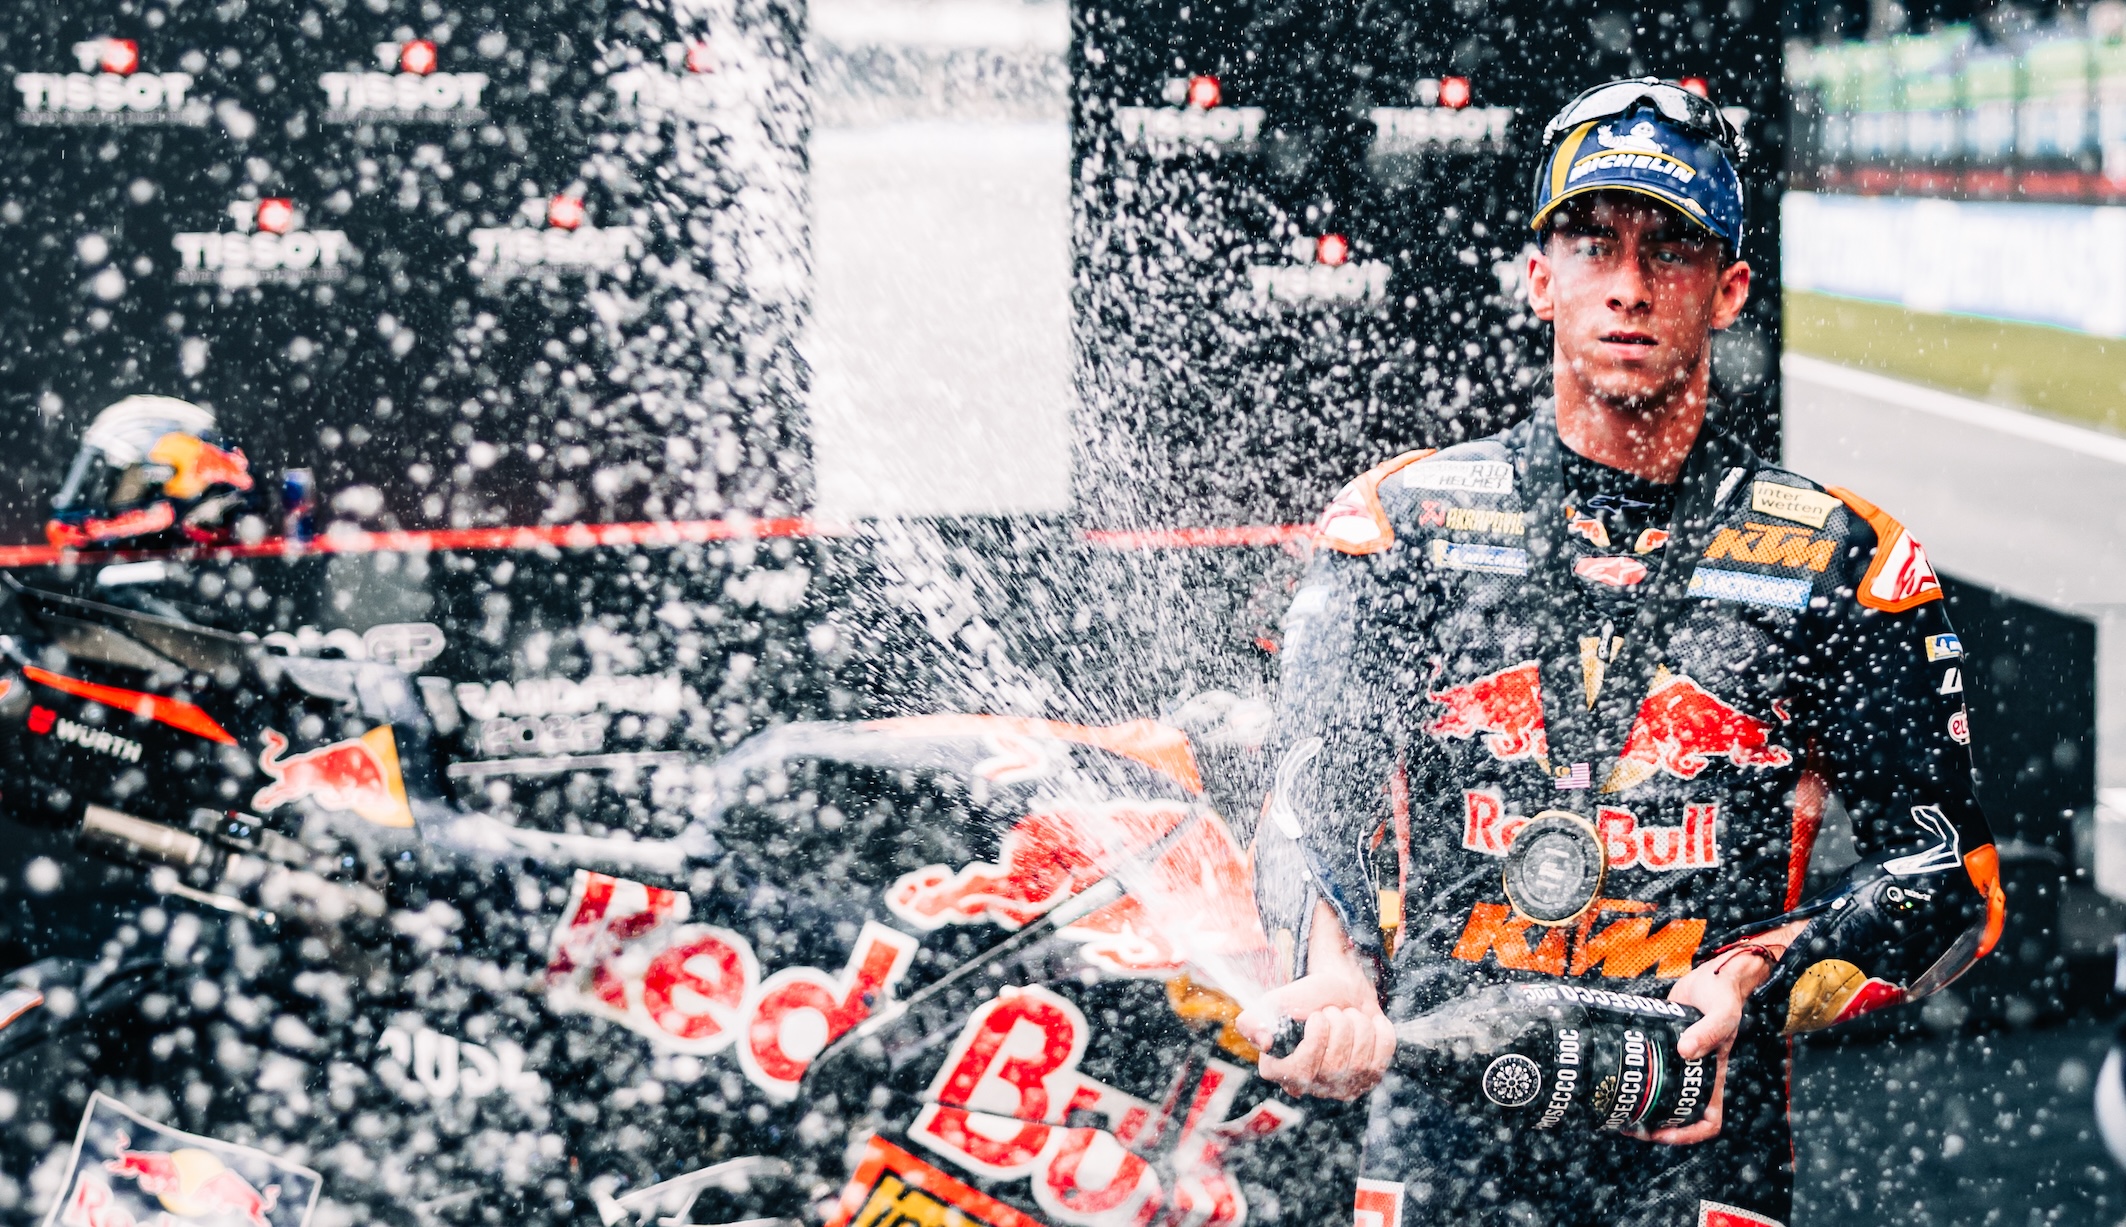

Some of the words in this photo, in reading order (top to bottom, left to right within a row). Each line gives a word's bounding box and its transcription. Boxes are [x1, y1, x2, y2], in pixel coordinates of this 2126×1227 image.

[15, 72, 193, 112] TISSOT
[319, 72, 489, 111] TISSOT
[1119, 106, 1266, 142] TISSOT
[1371, 106, 1514, 141] TISSOT
[1568, 153, 1697, 184] MICHELIN
[172, 231, 346, 269] TISSOT
[468, 226, 640, 264] TISSOT
[1438, 475, 1504, 489] HELMET
[1757, 481, 1802, 501] inter
[1760, 497, 1824, 516] wetten
[1702, 521, 1839, 573] KTM
[1596, 803, 1720, 870] Bull
[1451, 899, 1708, 980] KTM
[1558, 985, 1686, 1018] PROSECCO
[1558, 1028, 1580, 1065] DOC
[1624, 1030, 1645, 1067] DOC
